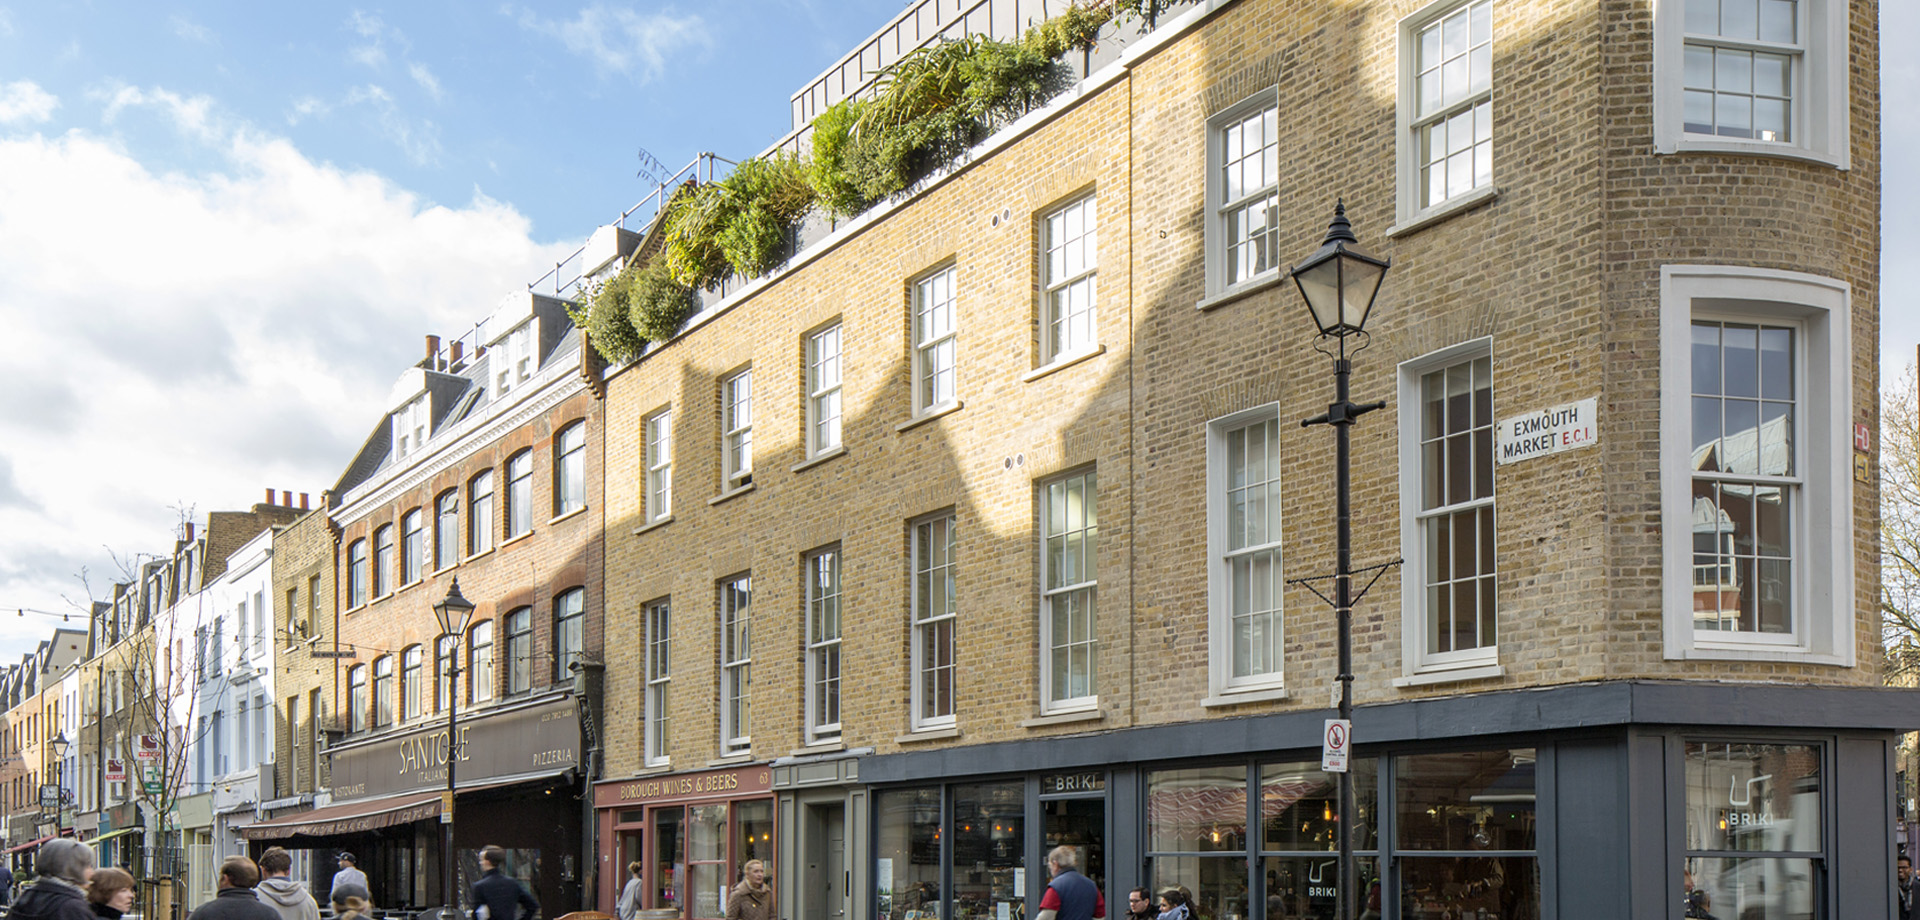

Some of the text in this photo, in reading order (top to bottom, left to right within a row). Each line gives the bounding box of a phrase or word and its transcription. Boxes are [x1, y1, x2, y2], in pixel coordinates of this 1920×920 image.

[1514, 408, 1578, 437] EXMOUTH
[1504, 433, 1557, 458] MARKET
[533, 748, 573, 767] PIZZERIA
[418, 768, 449, 783] ITALIANO
[1056, 775, 1096, 791] BRIKI
[621, 782, 660, 799] BOROUGH
[662, 778, 692, 795] WINES
[696, 777, 703, 792] &
[706, 773, 738, 792] BEERS
[759, 771, 768, 784] 63
[1730, 813, 1774, 825] BRIKI
[1309, 887, 1337, 897] BRIKI
